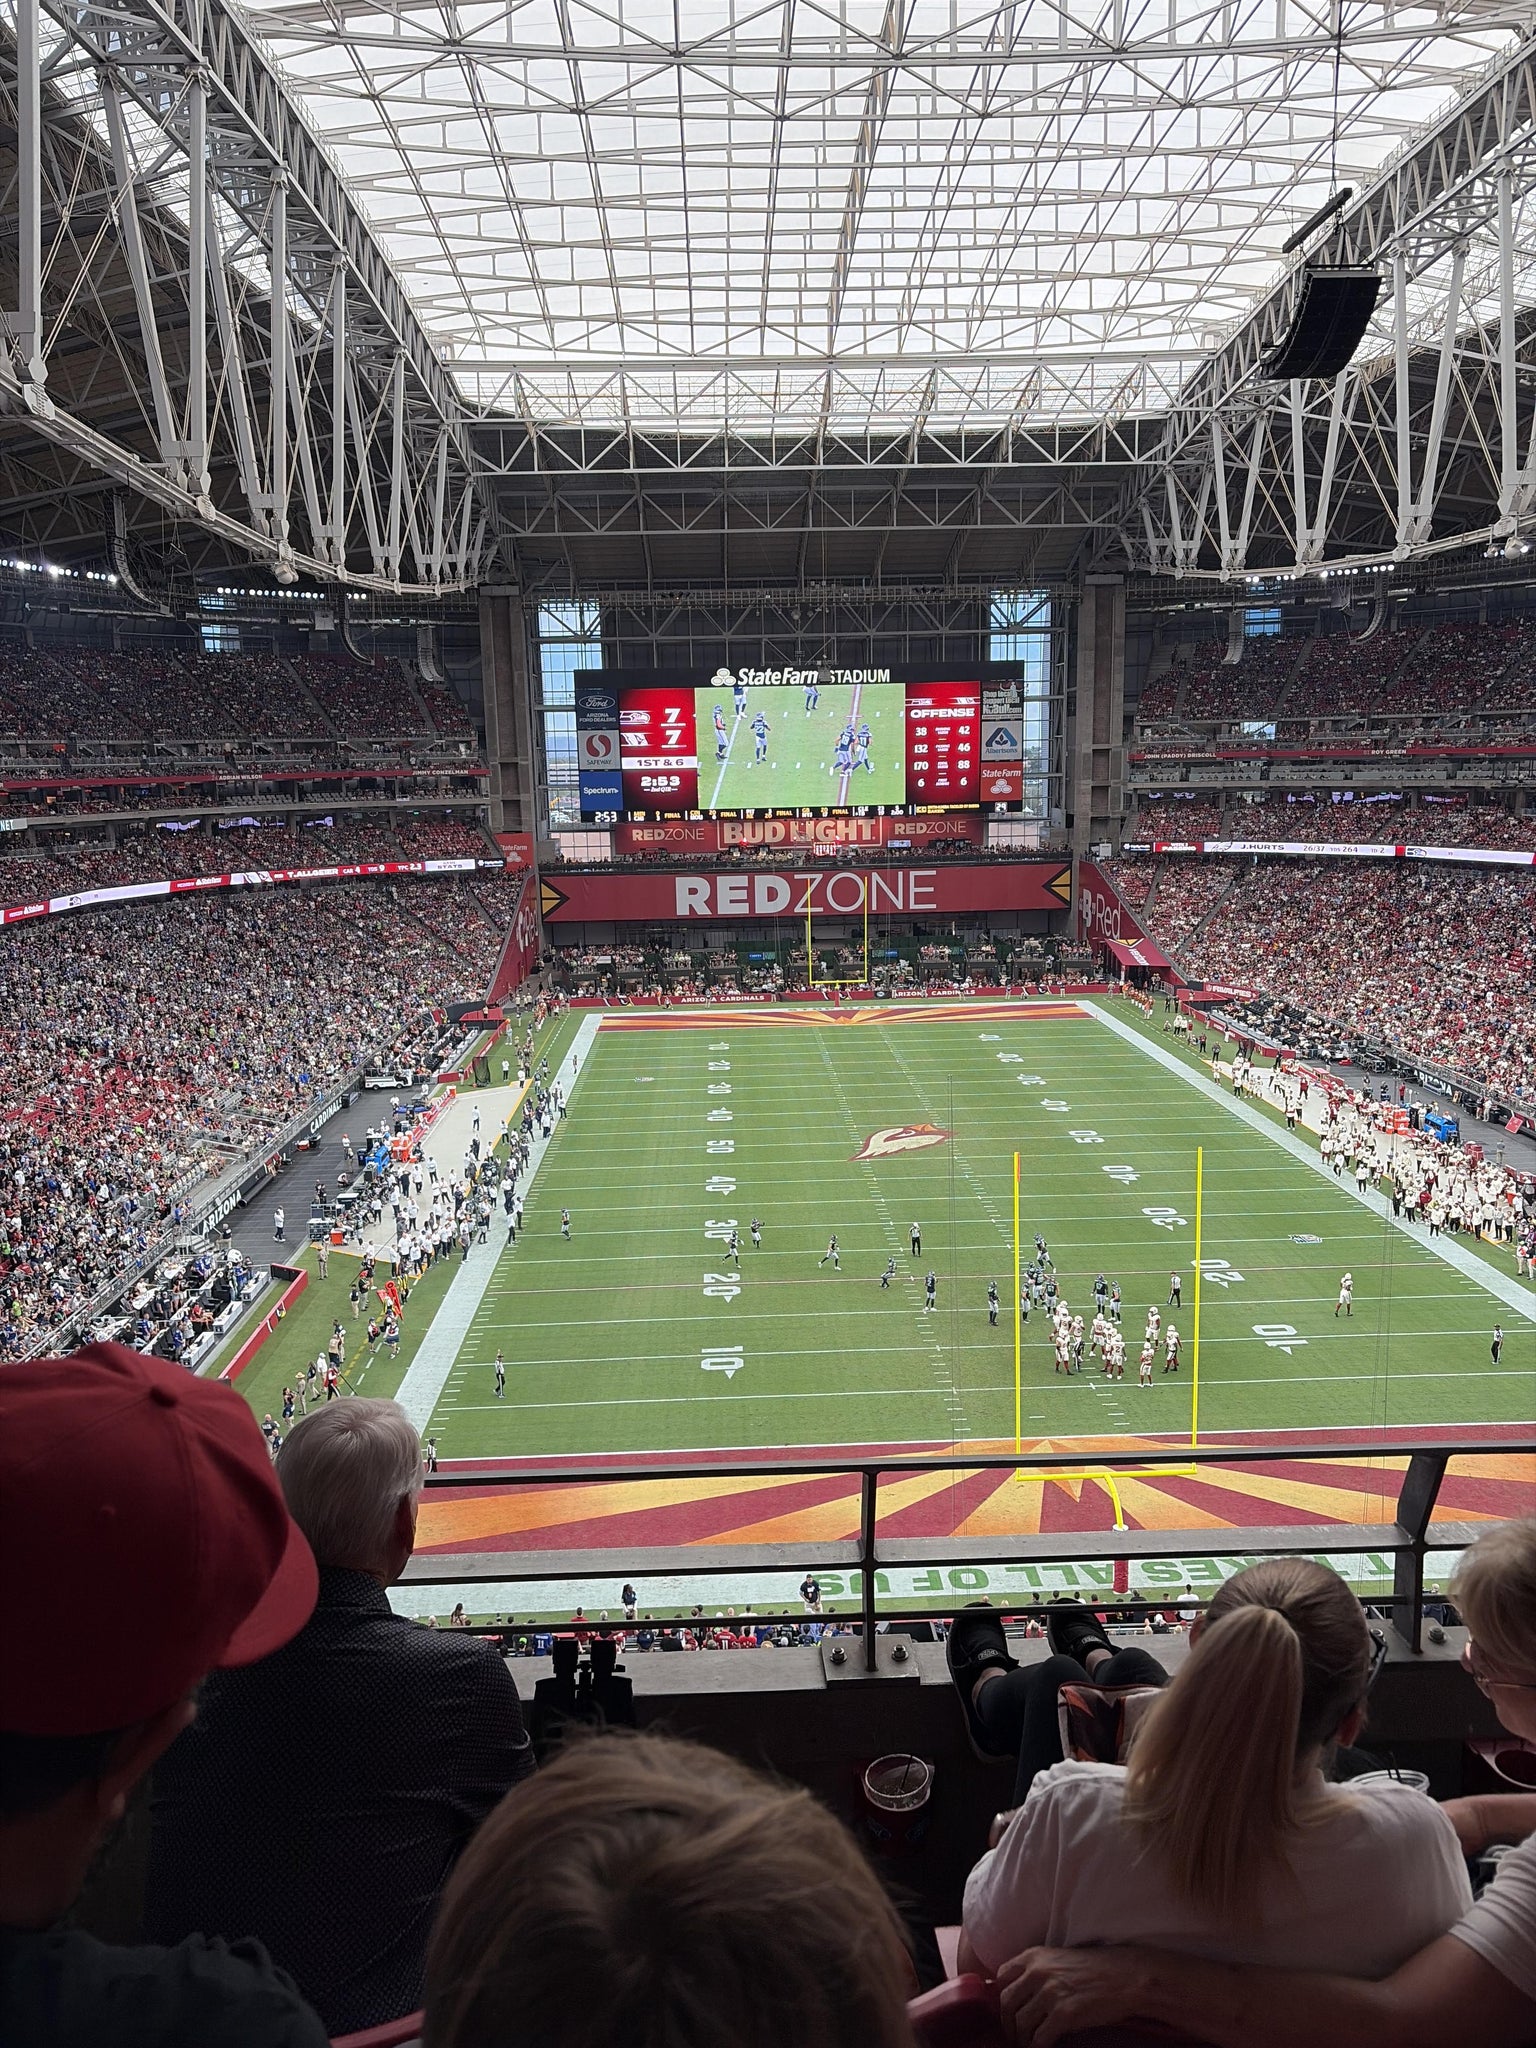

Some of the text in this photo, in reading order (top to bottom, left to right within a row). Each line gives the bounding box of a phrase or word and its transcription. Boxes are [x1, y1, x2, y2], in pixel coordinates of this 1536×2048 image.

[586, 697, 608, 707] Ford
[664, 708, 681, 722] 7
[910, 708, 976, 718] OFFENSE
[666, 730, 682, 744] 7
[916, 727, 928, 736] 38
[958, 726, 970, 735] 42
[914, 744, 928, 754] 132
[958, 743, 970, 752] 46
[914, 761, 929, 770] 170
[958, 760, 970, 769] 88
[641, 776, 680, 786] 2:53
[918, 778, 925, 788] 6
[960, 777, 968, 786] 6
[584, 788, 616, 796] Spectrum
[595, 811, 618, 822] 2:53
[632, 828, 704, 840] REDZONE
[724, 819, 876, 844] BUD LIGHT
[894, 821, 966, 835] REDZONE
[675, 870, 937, 916] REDZONE
[1068, 1130, 1105, 1144] 50
[706, 1140, 734, 1153] 50
[1102, 1165, 1140, 1181] 40
[705, 1176, 736, 1192] 40
[202, 1190, 242, 1238] ARIZONA
[1142, 1207, 1188, 1226] 30
[1190, 1259, 1245, 1282] 20
[703, 1272, 741, 1296] 20
[1252, 1324, 1308, 1347] 10
[701, 1346, 744, 1370] 10
[912, 1568, 989, 1592] OF
[1005, 1563, 1115, 1587] ALL
[812, 1571, 891, 1596] US
